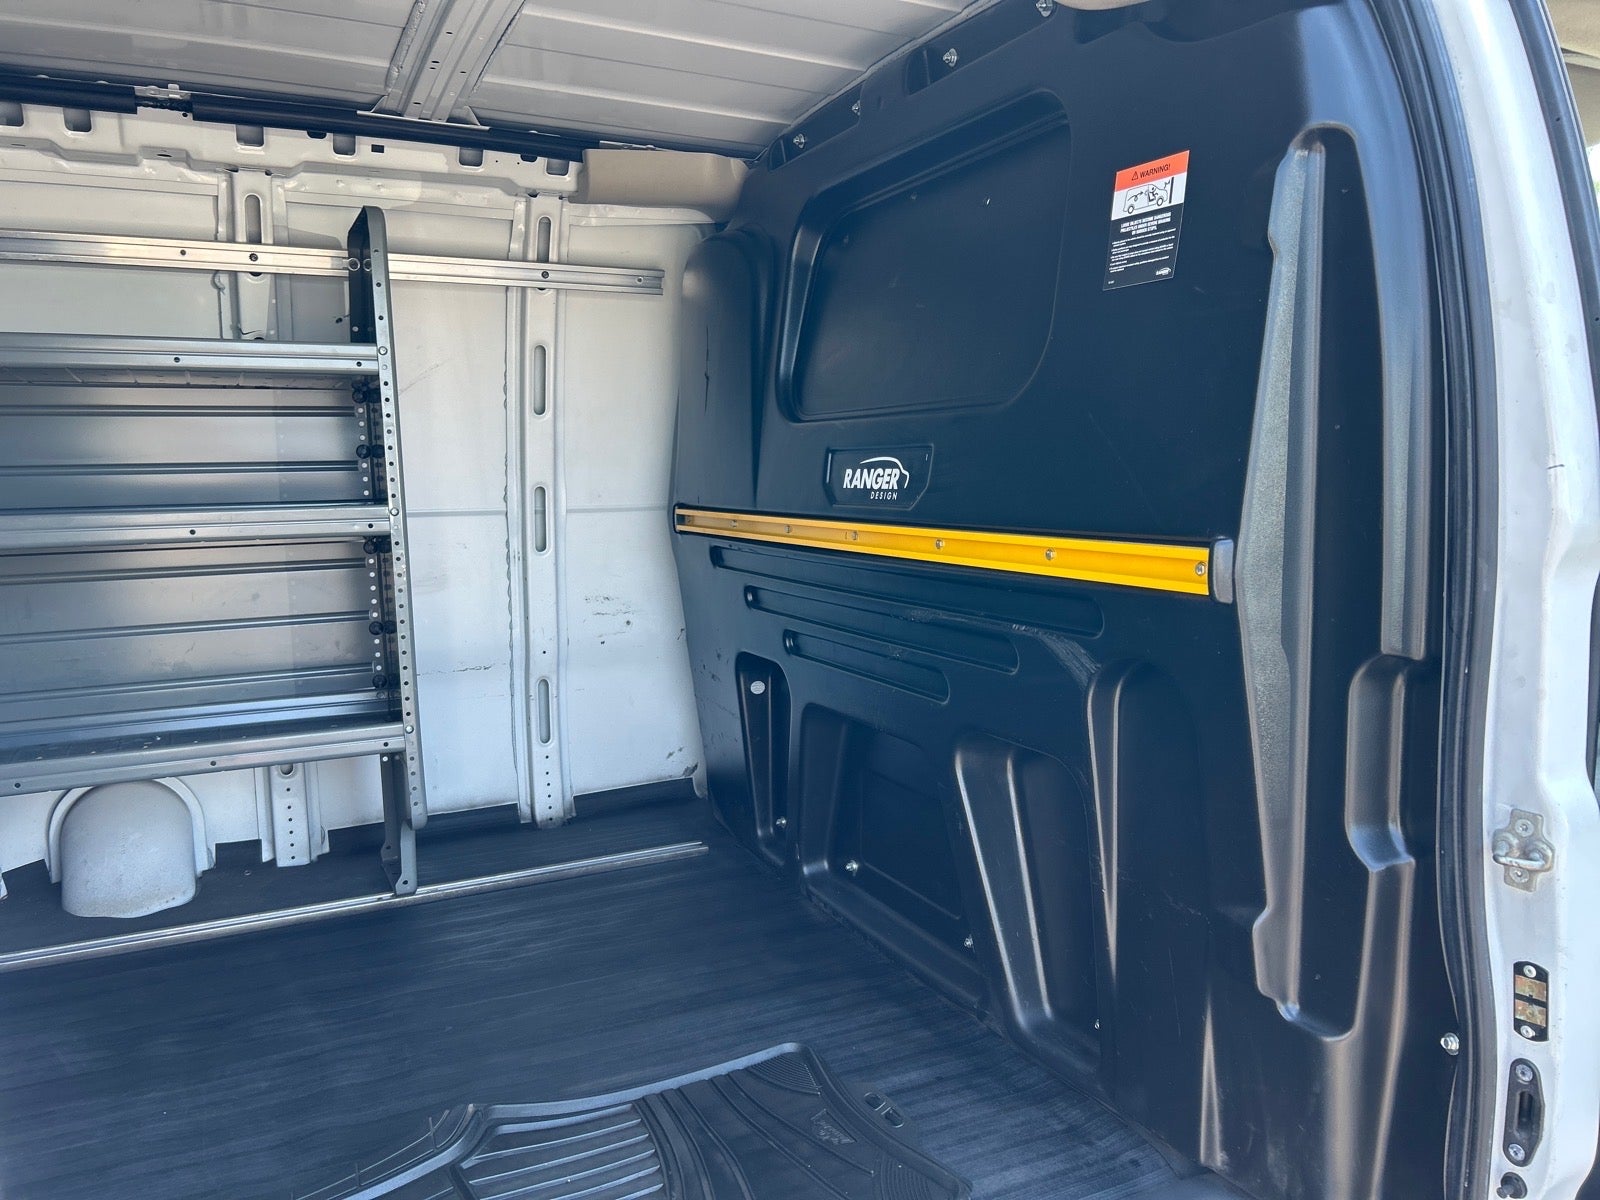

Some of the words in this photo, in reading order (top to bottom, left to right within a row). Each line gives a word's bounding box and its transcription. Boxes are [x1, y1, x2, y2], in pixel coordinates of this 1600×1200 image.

[1140, 163, 1171, 178] WARNING!
[843, 468, 900, 490] RANGER
[870, 491, 898, 500] DESIGN
